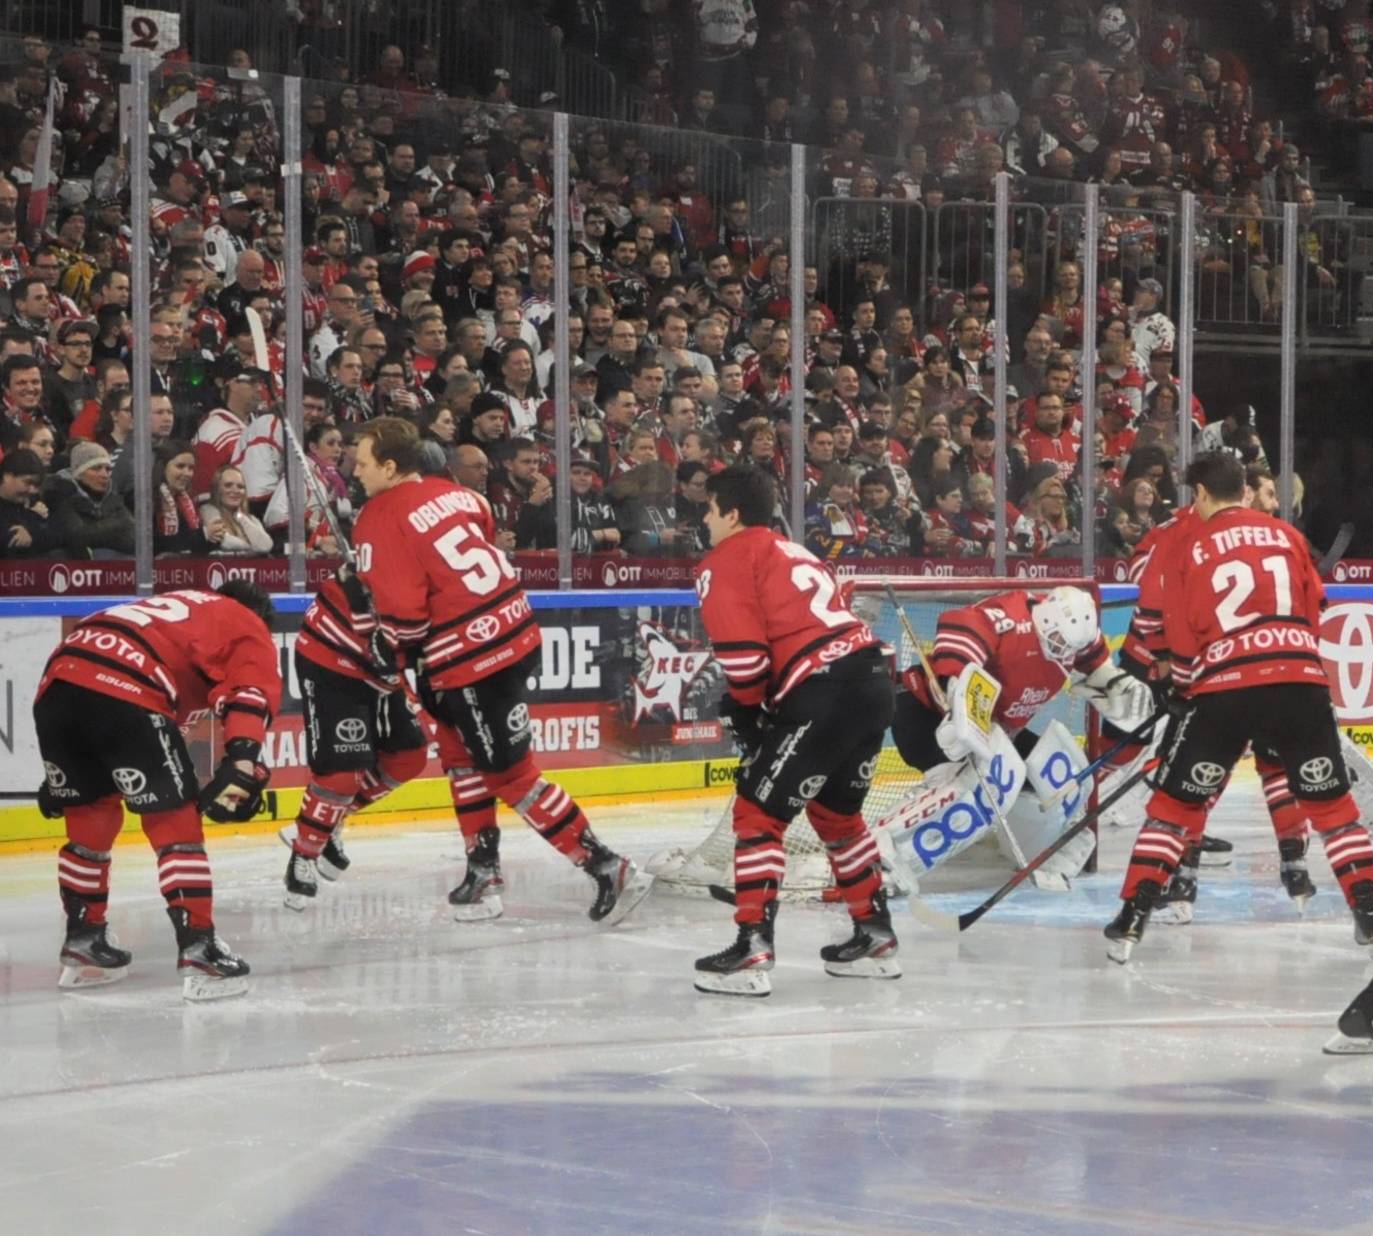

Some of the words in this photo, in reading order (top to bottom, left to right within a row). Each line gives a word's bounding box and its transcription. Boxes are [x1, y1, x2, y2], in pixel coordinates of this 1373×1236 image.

[71, 569, 102, 587] OTT
[105, 569, 194, 586] IMMBILIEN
[618, 566, 642, 582] OTT
[643, 567, 698, 582] IMMOBILIE
[836, 565, 857, 576] OTT
[934, 565, 954, 577] OTT
[1029, 565, 1049, 577] OTT
[1348, 566, 1372, 579] OTT
[1211, 554, 1293, 634] 21
[65, 629, 146, 668] OYOTA
[656, 656, 696, 675] KEC
